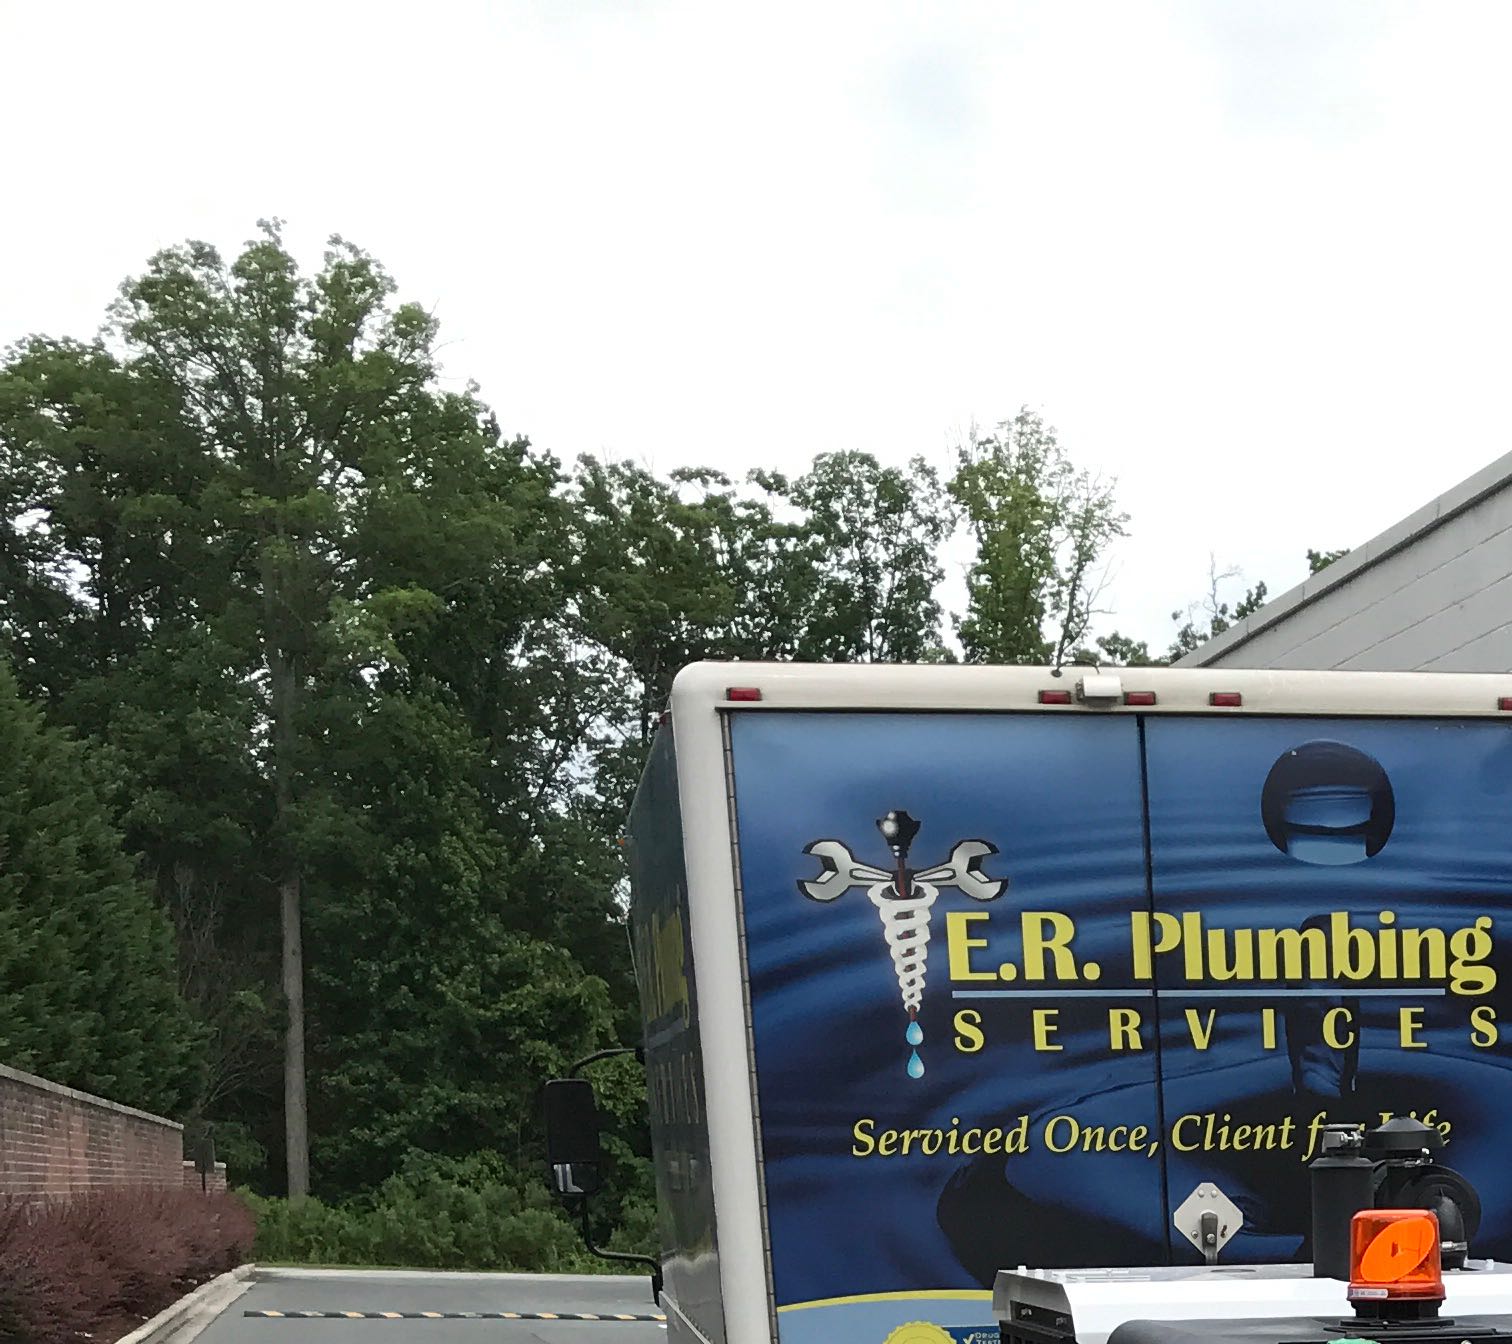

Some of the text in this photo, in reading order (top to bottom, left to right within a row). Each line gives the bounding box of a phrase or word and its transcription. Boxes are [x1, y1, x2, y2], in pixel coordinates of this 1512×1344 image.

[946, 910, 1497, 995] E.R. Plumbing
[953, 1006, 1499, 1052] SERVICES
[851, 1116, 1030, 1157] Serviced
[1044, 1114, 1160, 1158] Once,
[1171, 1112, 1296, 1152] Client
